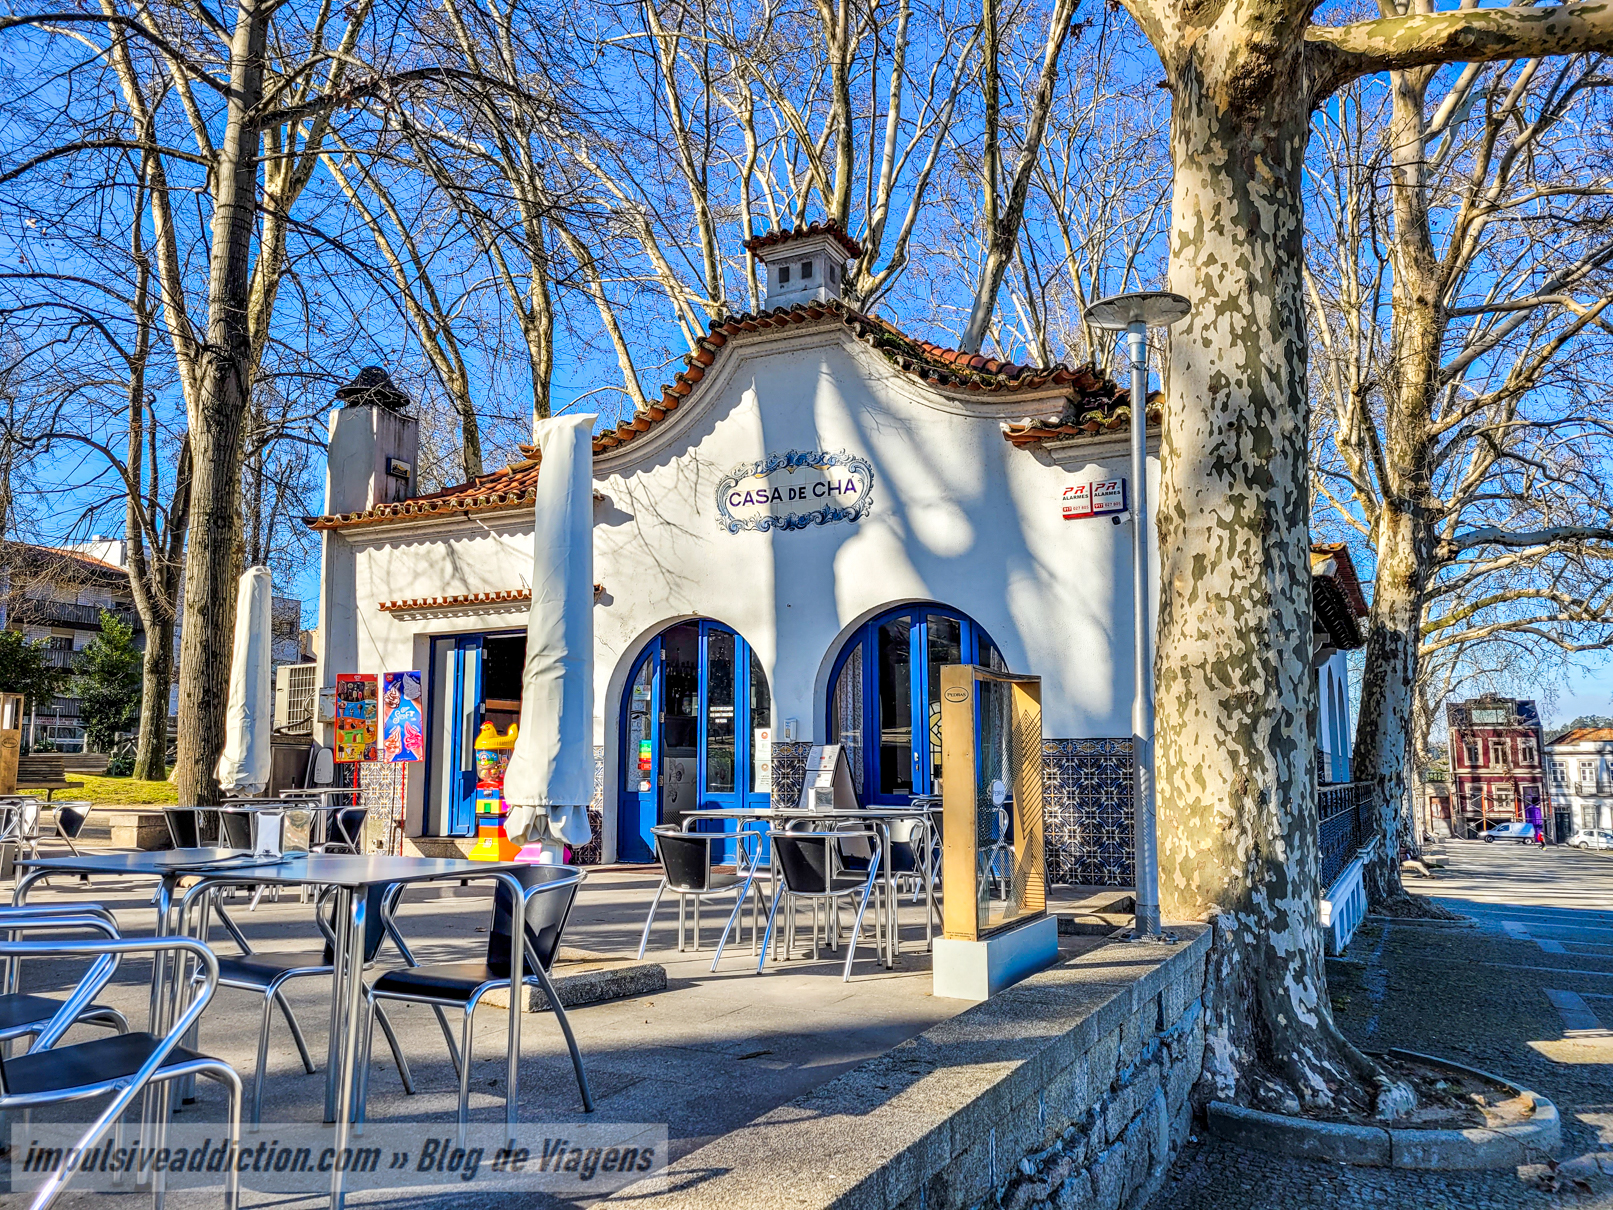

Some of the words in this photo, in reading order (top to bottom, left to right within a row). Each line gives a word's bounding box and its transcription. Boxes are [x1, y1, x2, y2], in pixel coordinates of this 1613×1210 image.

[729, 487, 783, 507] CASA
[788, 486, 807, 500] DE
[812, 475, 857, 497] CHÁ
[1063, 486, 1086, 496] PR
[1094, 482, 1118, 492] PR
